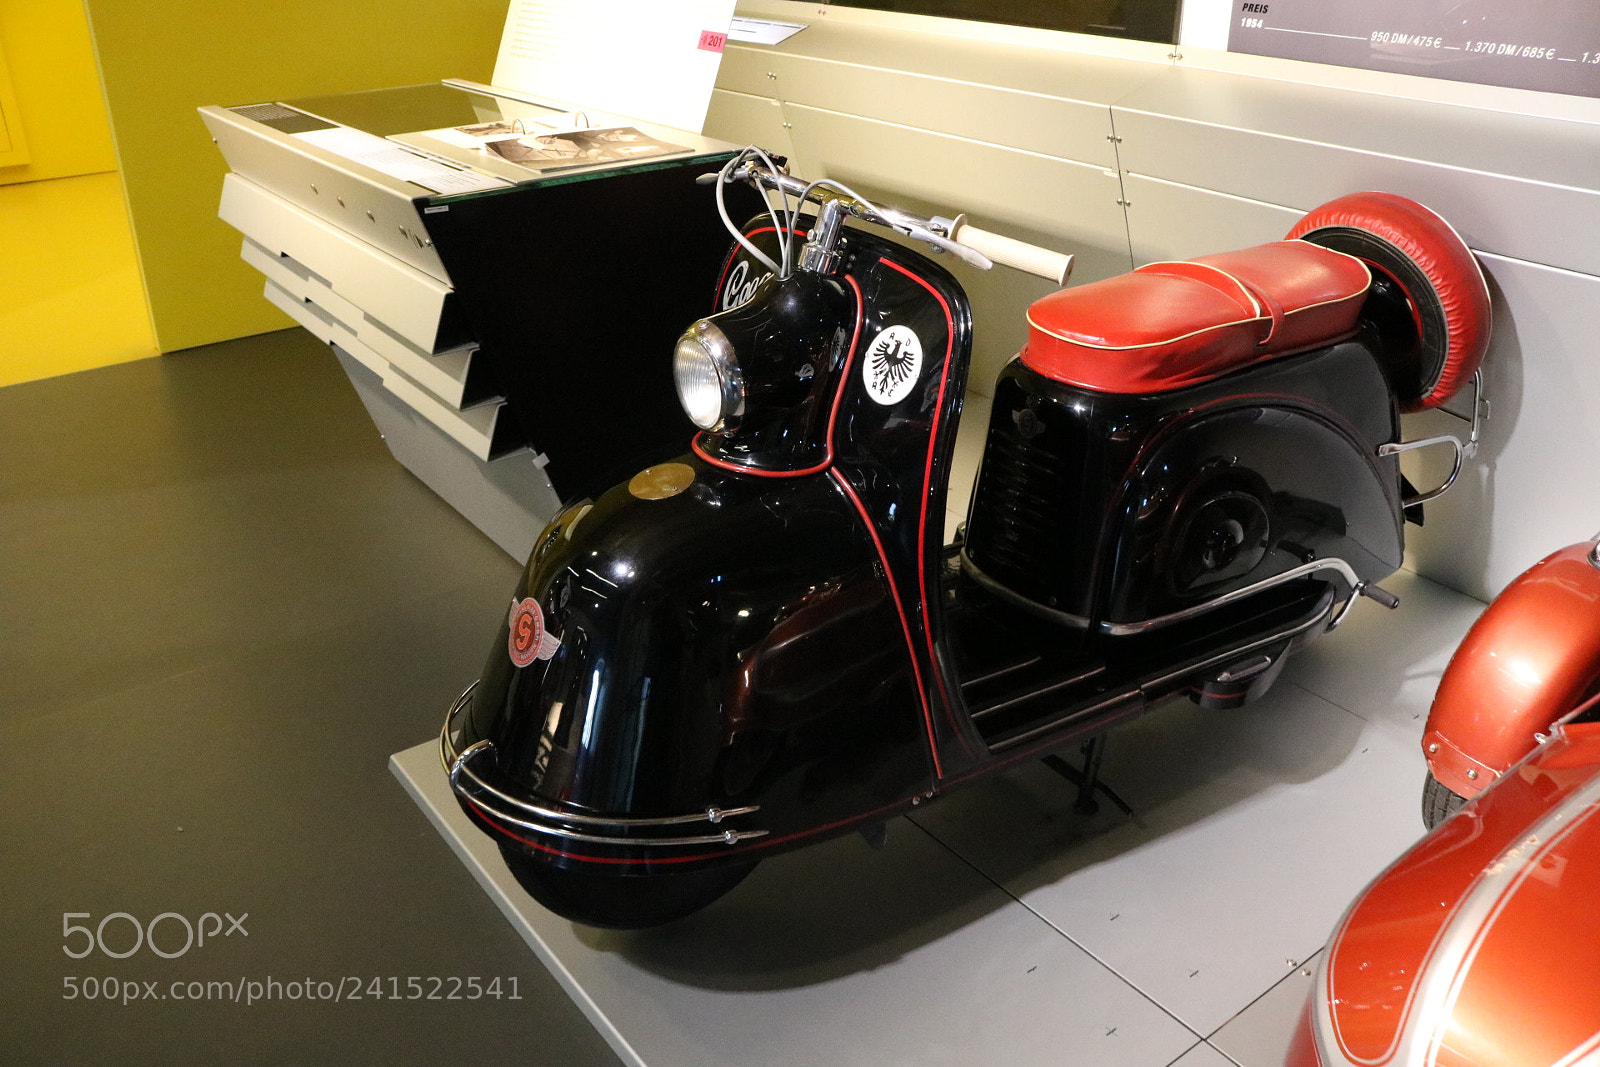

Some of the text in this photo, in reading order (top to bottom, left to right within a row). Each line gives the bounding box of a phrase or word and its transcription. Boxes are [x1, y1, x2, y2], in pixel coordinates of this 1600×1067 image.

[1242, 2, 1269, 14] PREIS
[708, 35, 723, 48] 201
[1241, 17, 1263, 29] 1954
[1370, 31, 1390, 43] 950
[1464, 41, 1496, 54] 1.370
